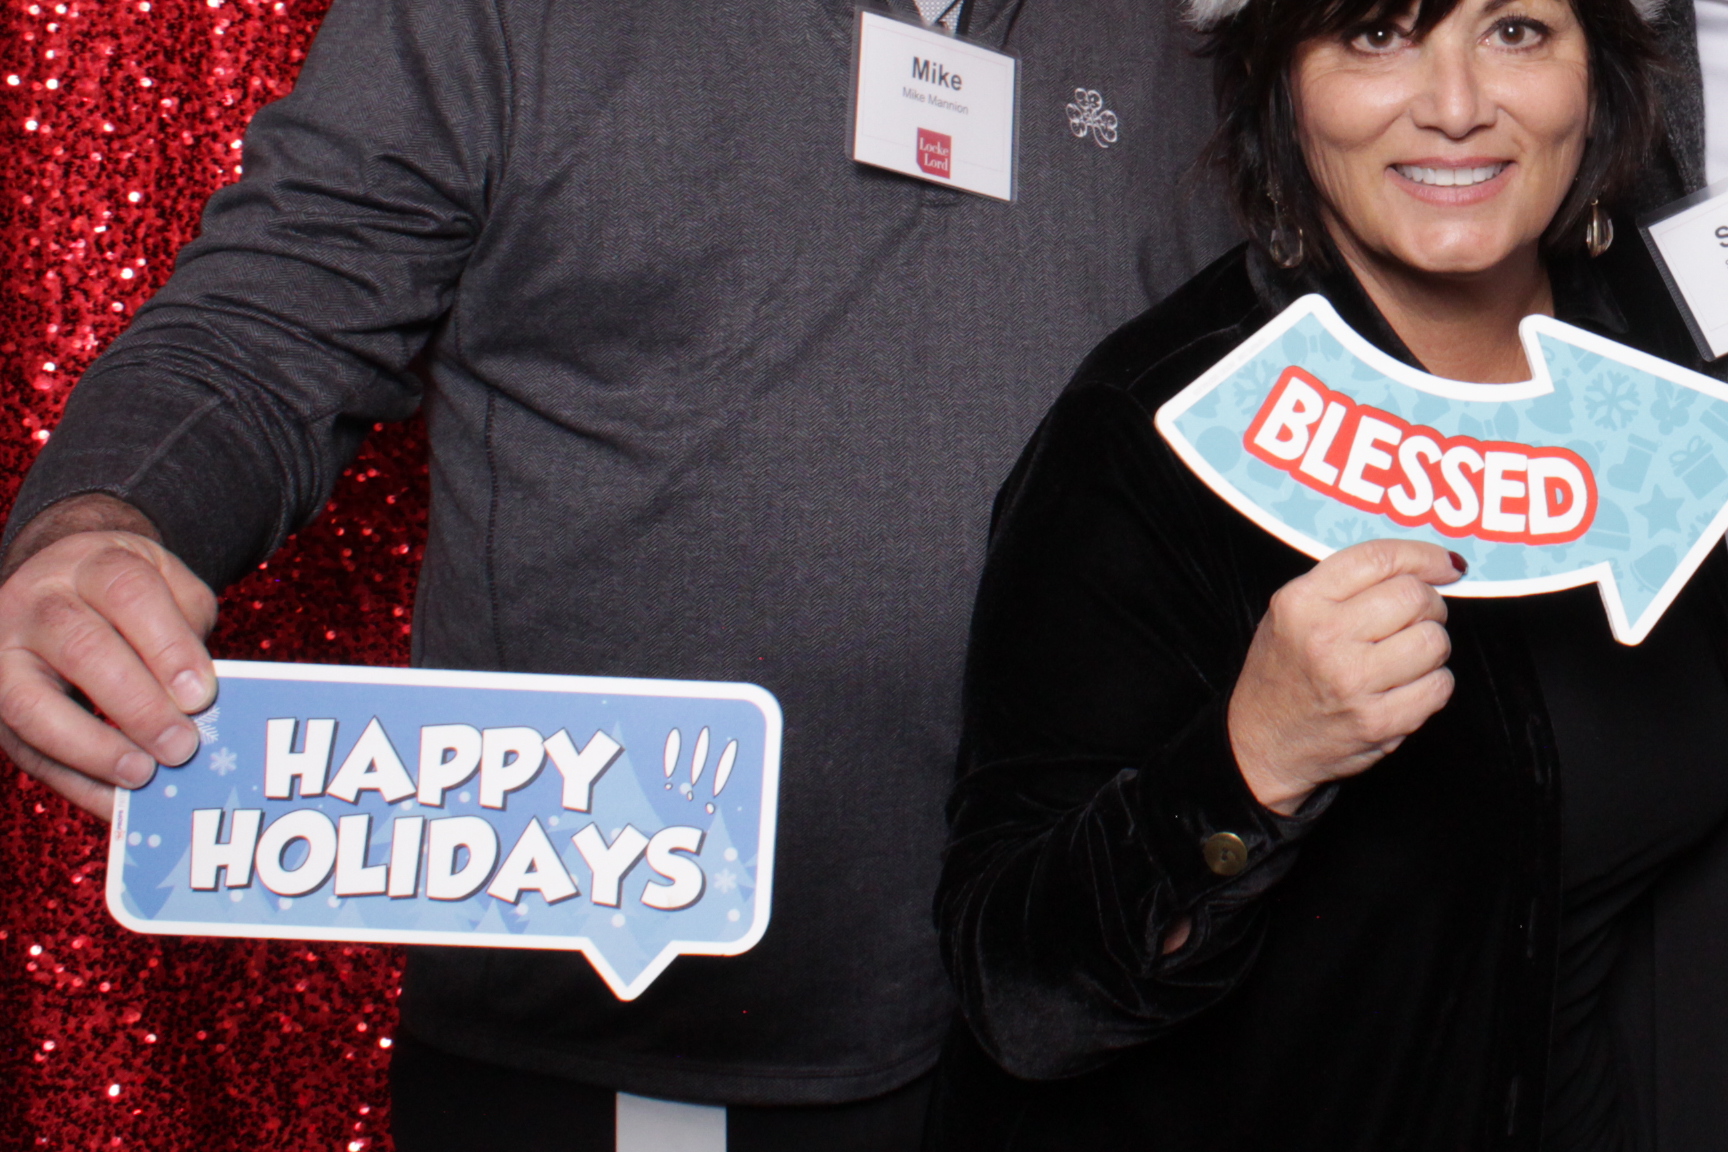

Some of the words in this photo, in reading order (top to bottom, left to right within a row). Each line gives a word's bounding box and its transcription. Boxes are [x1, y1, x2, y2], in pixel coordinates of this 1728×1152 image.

[911, 56, 963, 91] Mike
[902, 87, 926, 103] Mike
[928, 94, 969, 115] Mannion
[919, 138, 949, 156] Locke
[924, 153, 949, 171] Lord
[1253, 376, 1588, 535] BLESSED
[264, 716, 625, 813] HAPPY
[189, 808, 708, 911] HOLIDAYS
